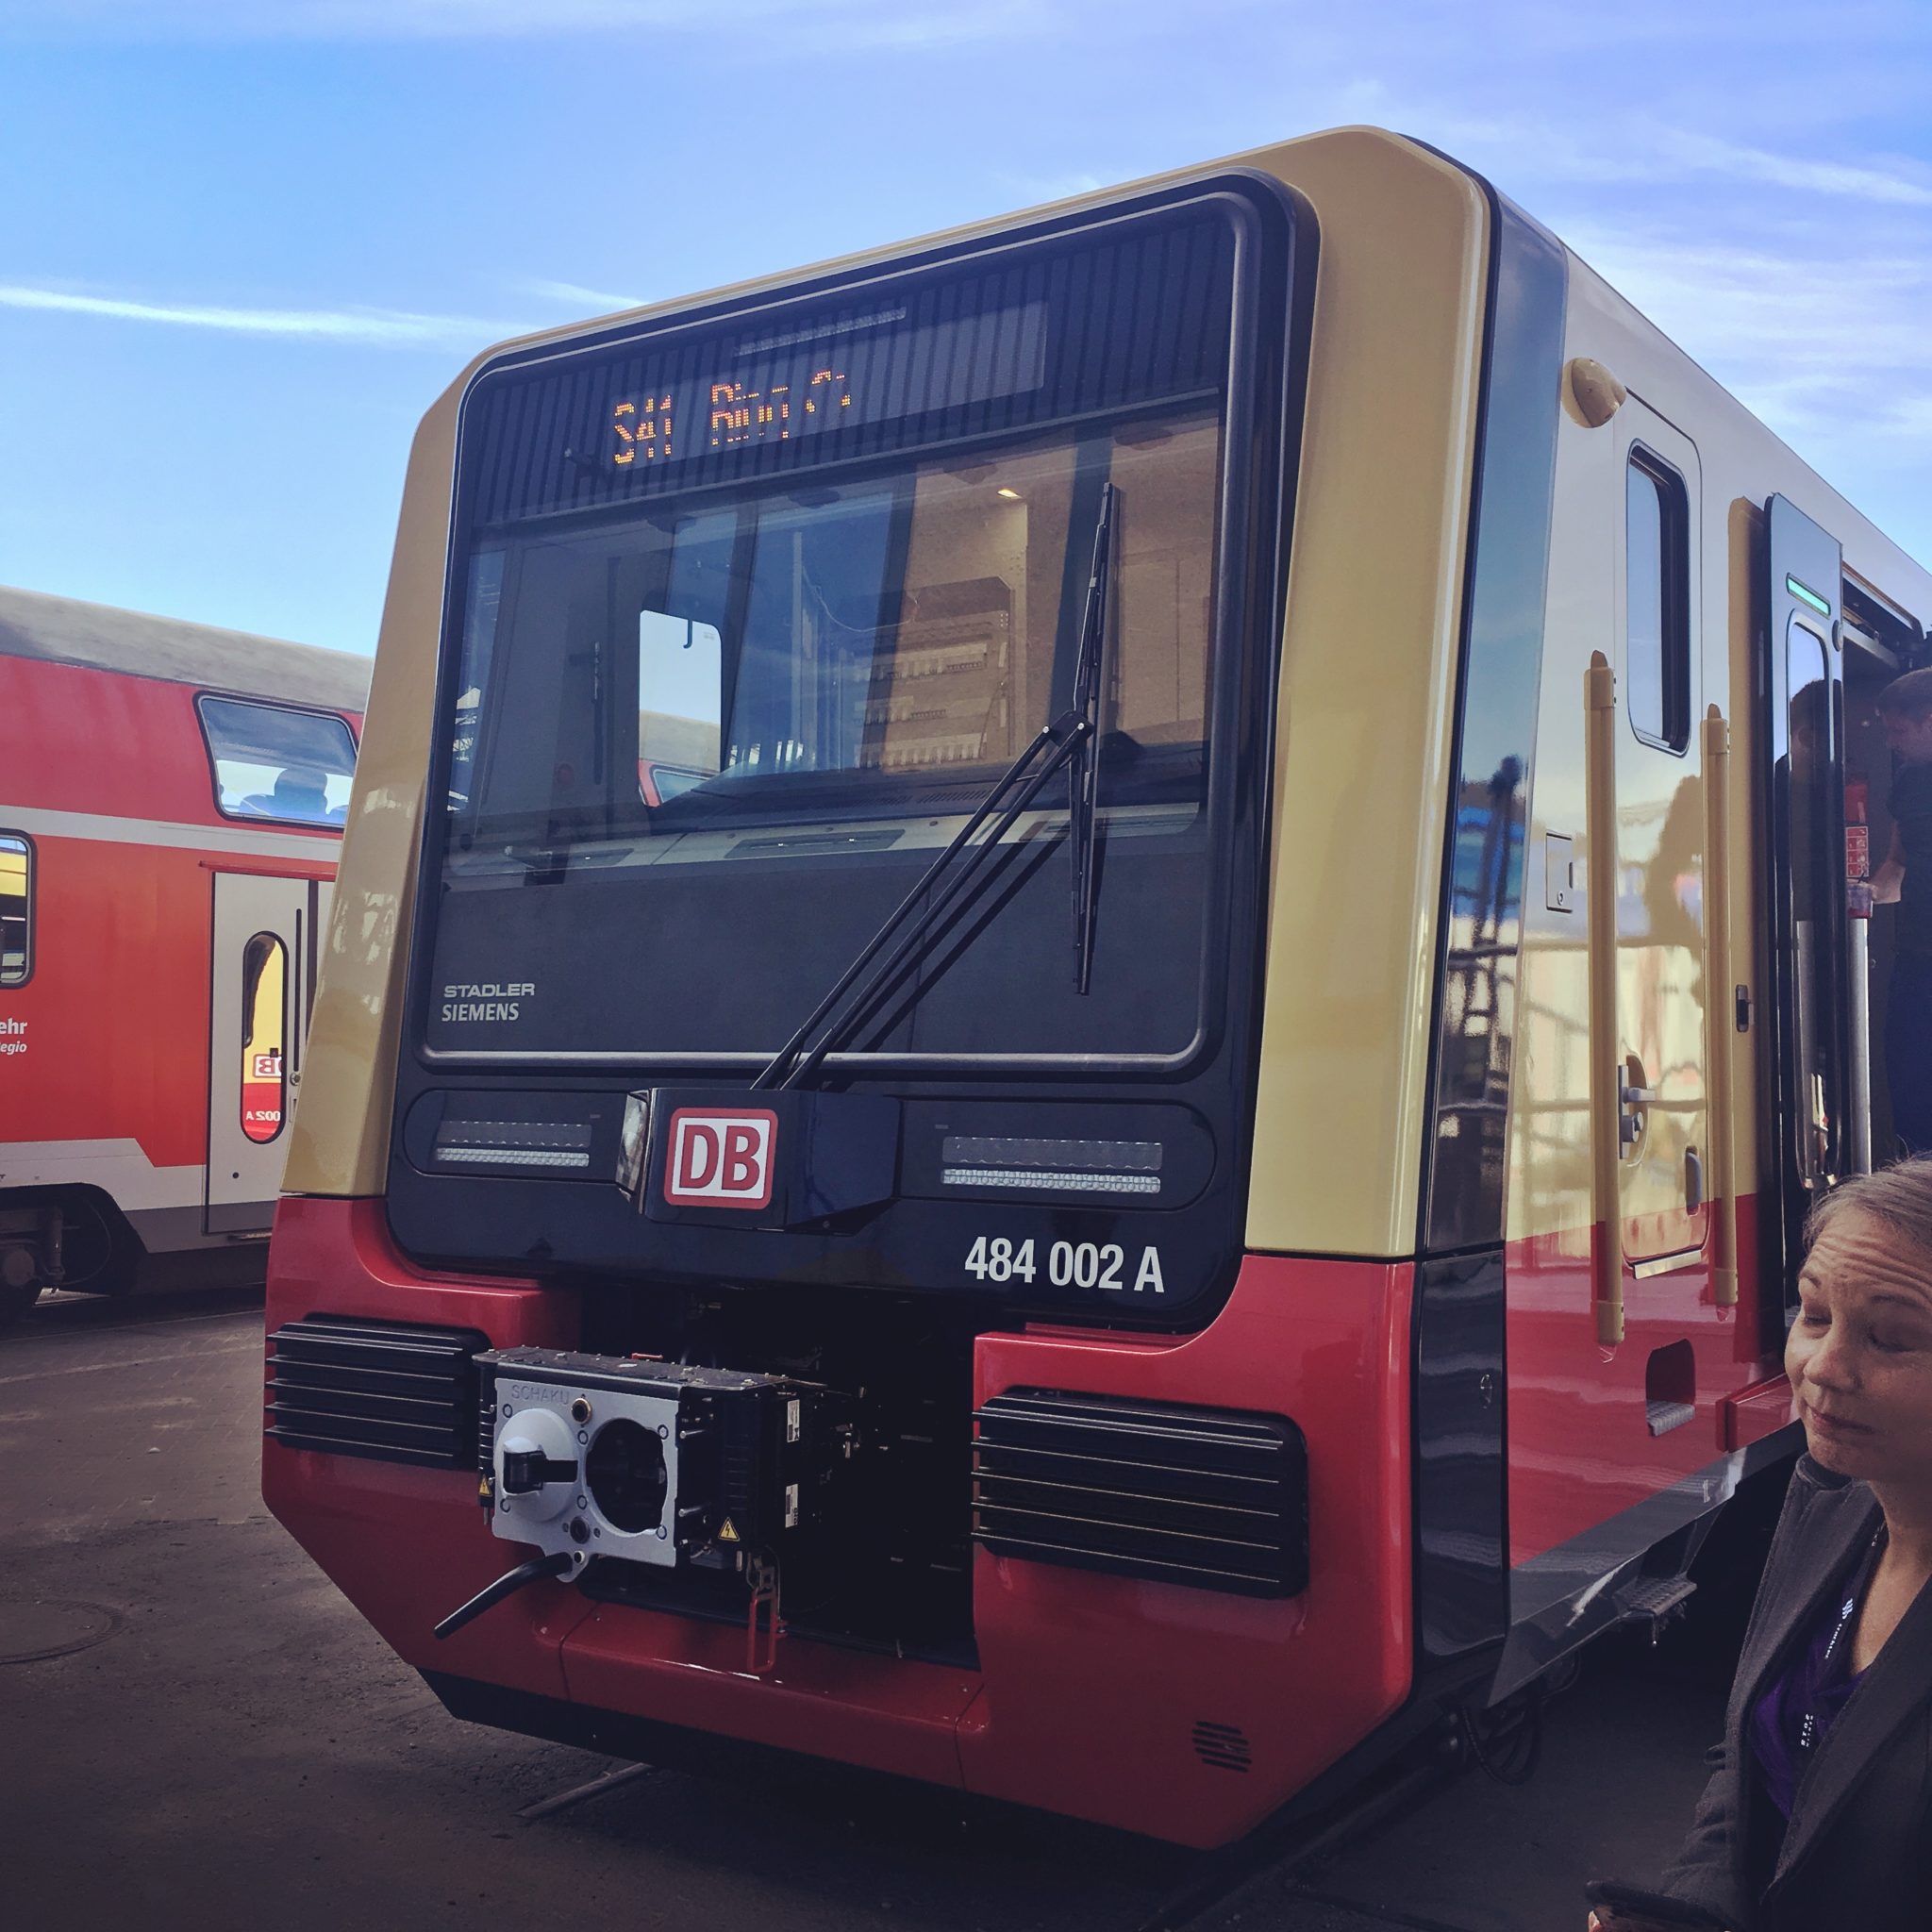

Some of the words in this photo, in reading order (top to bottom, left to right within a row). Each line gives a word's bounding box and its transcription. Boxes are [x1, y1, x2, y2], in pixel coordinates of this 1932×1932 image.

[614, 394, 672, 464] S41
[443, 983, 536, 998] STADLER
[441, 1003, 520, 1022] SIEMENS
[0, 1041, 27, 1056] egio
[679, 1124, 761, 1191] DB
[964, 1236, 1037, 1283] 484
[1049, 1241, 1124, 1290] 002
[1134, 1246, 1165, 1293] A
